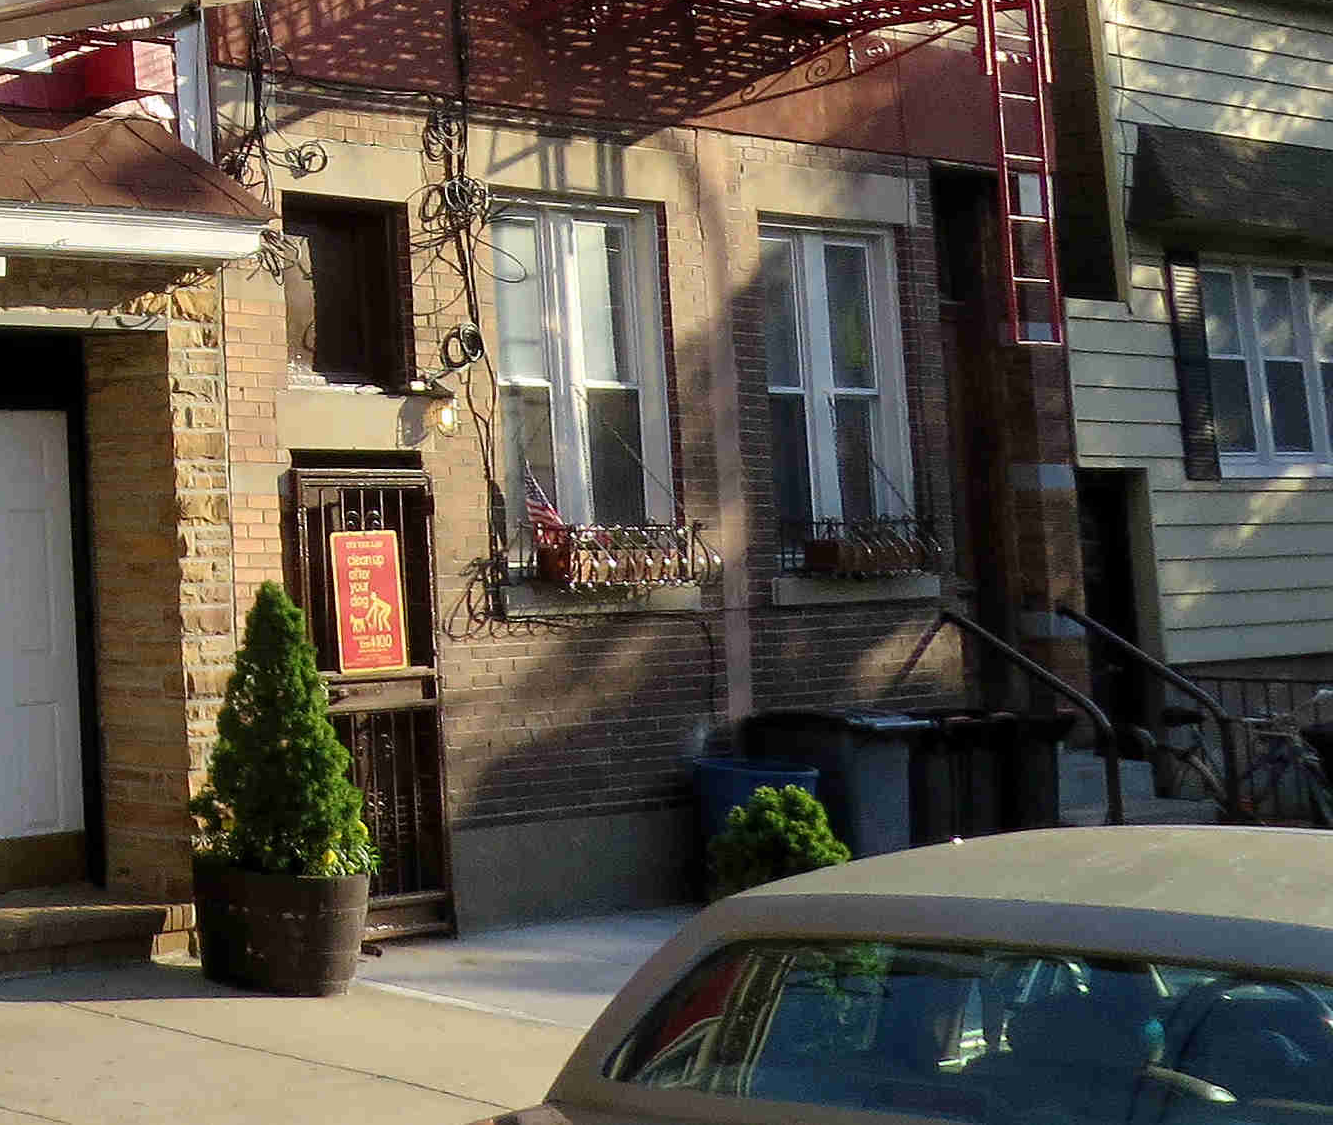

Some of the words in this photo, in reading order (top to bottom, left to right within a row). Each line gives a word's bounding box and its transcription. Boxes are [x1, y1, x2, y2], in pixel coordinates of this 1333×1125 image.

[347, 554, 371, 566] clean
[349, 581, 369, 594] your
[349, 594, 369, 609] dog
